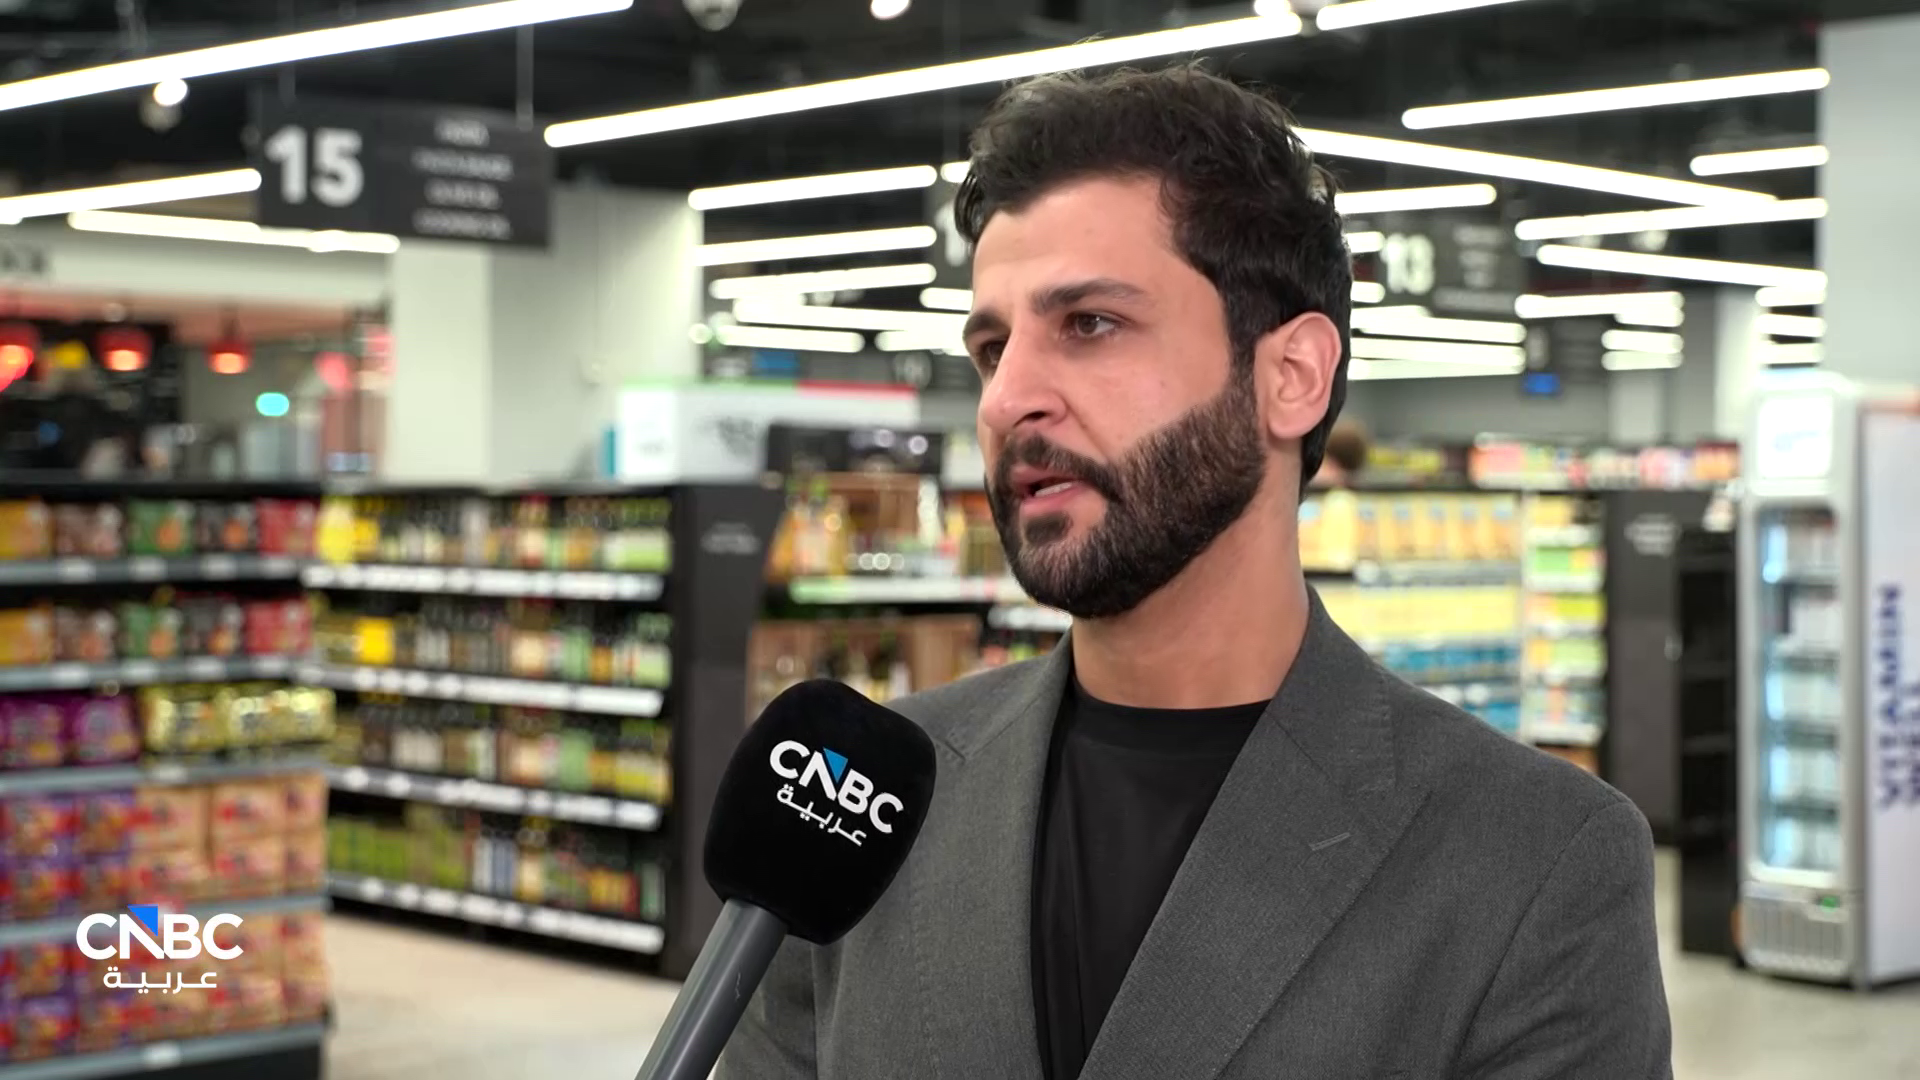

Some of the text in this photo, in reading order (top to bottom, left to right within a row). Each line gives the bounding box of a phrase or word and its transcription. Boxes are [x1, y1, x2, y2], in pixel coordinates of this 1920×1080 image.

[264, 124, 365, 207] 15
[1380, 233, 1435, 295] 13
[770, 740, 904, 834] CNBC
[777, 783, 867, 847] عربية
